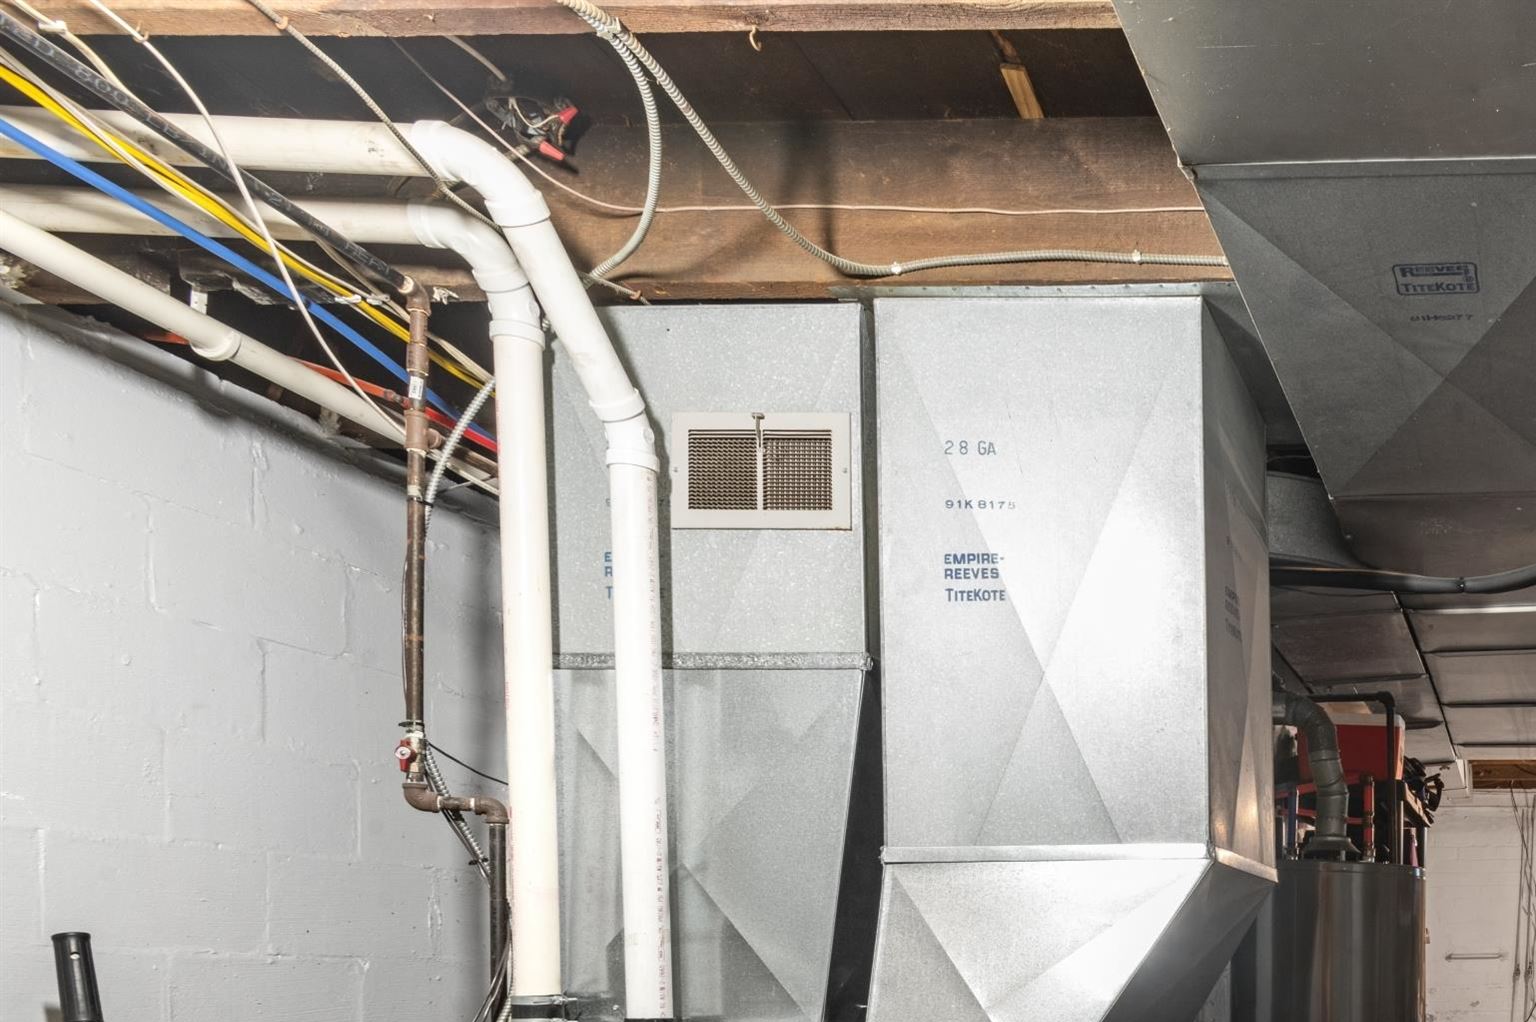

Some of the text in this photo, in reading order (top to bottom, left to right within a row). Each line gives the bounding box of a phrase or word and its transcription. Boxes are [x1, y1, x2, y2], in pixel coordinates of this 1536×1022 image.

[944, 440, 996, 455] 28 GA
[944, 553, 1005, 564] EMPIRE-
[944, 568, 1000, 579] REEVES
